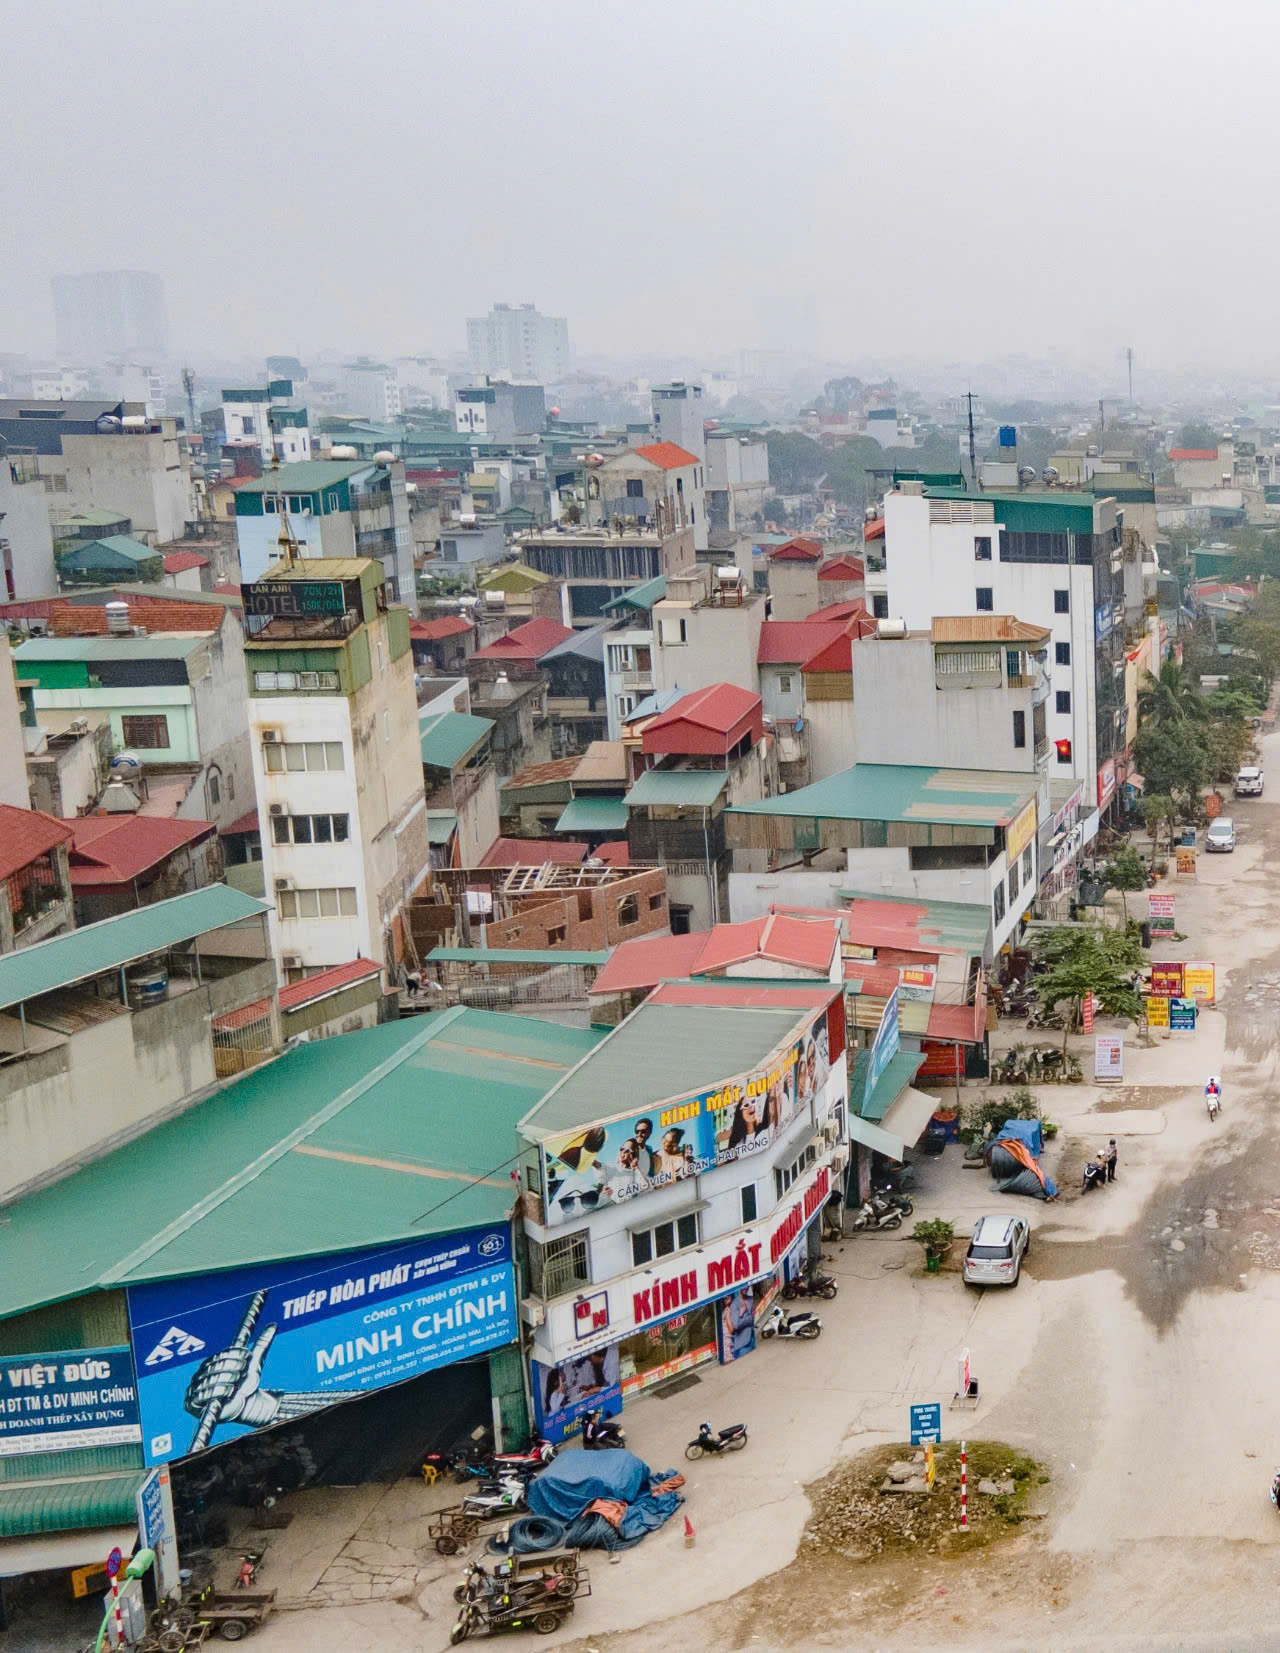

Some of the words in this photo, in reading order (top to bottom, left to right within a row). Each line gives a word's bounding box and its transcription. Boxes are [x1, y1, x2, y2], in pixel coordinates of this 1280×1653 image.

[244, 595, 300, 613] HOTEL
[250, 585, 269, 594] LAN
[660, 1101, 700, 1128] KÍNH
[706, 1085, 742, 1112] MẮT
[282, 1289, 328, 1320] THÉP
[329, 1278, 366, 1306] HÒA
[368, 1264, 412, 1293] PHÁT
[363, 1306, 398, 1324] CÔNG
[400, 1300, 415, 1313] TY
[416, 1291, 447, 1308] TNHH
[481, 1278, 489, 1286] &
[492, 1272, 506, 1284] DV
[633, 1269, 698, 1324] KÍNH
[707, 1238, 762, 1293] MẮT
[316, 1324, 402, 1374] MINH
[412, 1290, 507, 1340] CHÍNH
[8, 1364, 58, 1389] VIỆT
[63, 1358, 111, 1382] ĐỨC
[8, 1398, 22, 1413] ĐT
[24, 1395, 41, 1410] TM
[43, 1395, 52, 1410] &
[54, 1392, 68, 1408] DV
[70, 1390, 98, 1406] MINH
[100, 1384, 134, 1404] CHÍNH
[9, 1417, 44, 1430] DOANH
[46, 1412, 72, 1424] THÉP
[72, 1410, 94, 1422] XÂY
[96, 1409, 124, 1422] DỰNG
